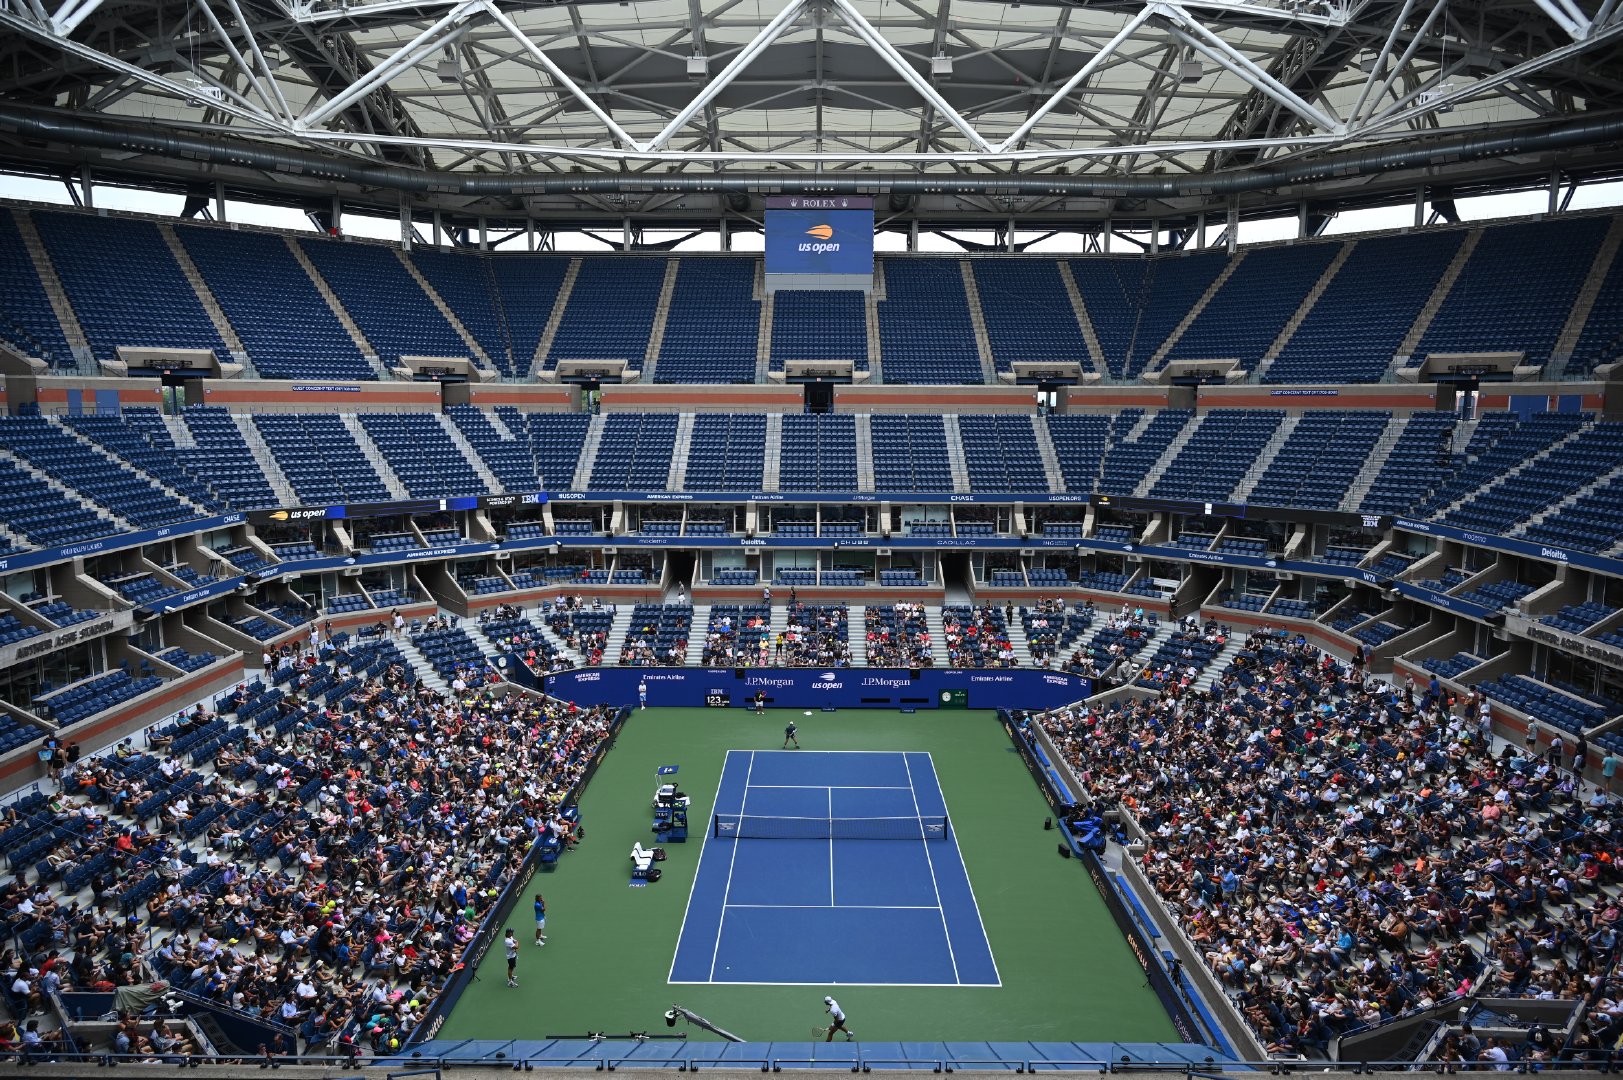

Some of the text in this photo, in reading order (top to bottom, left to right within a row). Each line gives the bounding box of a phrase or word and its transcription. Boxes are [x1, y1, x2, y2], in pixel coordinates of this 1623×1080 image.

[803, 199, 836, 208] ROLEX
[799, 243, 840, 254] us open
[521, 494, 539, 504] IBM
[223, 514, 241, 523] CHASE
[291, 509, 326, 520] us open
[407, 549, 433, 558] AMERICAN
[1541, 547, 1568, 560] Deloitte.
[54, 631, 78, 647] ASHE
[79, 620, 114, 639] STADIUM
[745, 677, 794, 688] J.P.Morgan
[823, 682, 842, 690] open
[861, 678, 911, 689] J.P.Morgan
[706, 696, 721, 704] 123
[471, 921, 500, 968] CADILLAC
